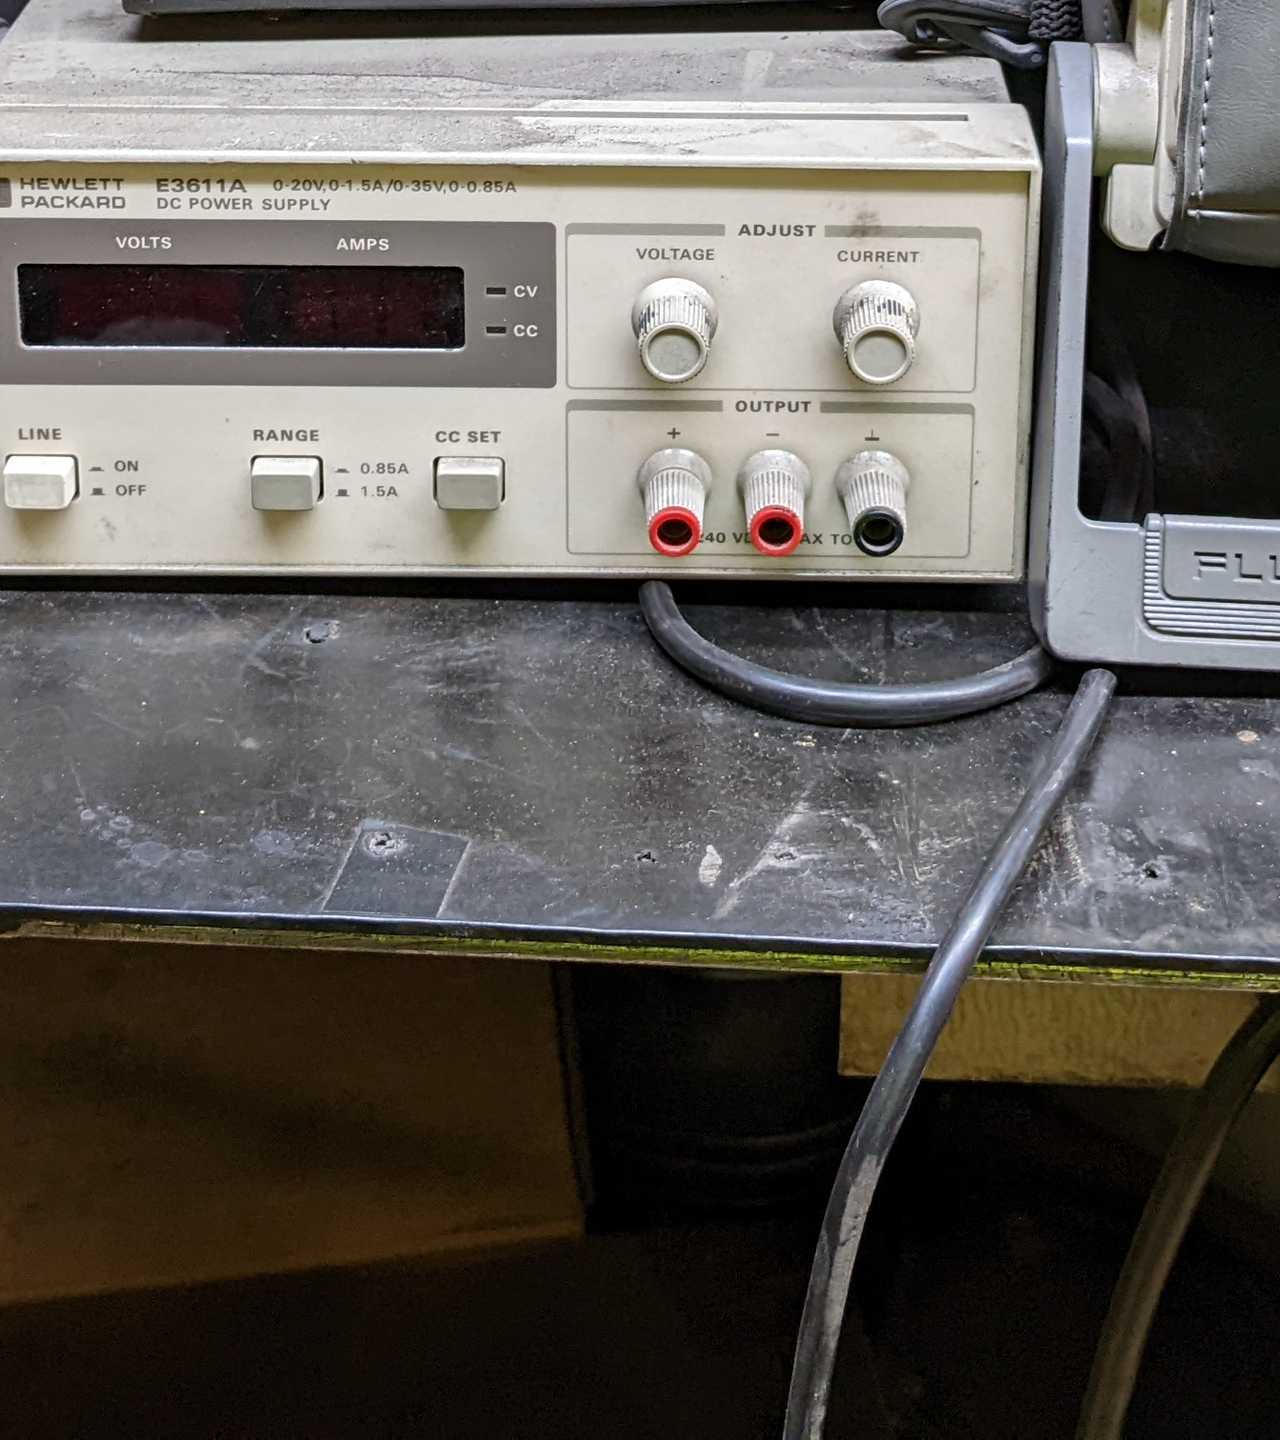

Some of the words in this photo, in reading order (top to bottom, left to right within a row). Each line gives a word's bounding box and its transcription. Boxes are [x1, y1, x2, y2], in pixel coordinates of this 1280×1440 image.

[21, 177, 124, 191] HEWLETT
[156, 178, 247, 193] E3611A
[21, 195, 126, 209] PACKARD
[156, 197, 182, 209] DC
[189, 198, 253, 210] POWER
[262, 198, 331, 211] SUPPLY
[738, 224, 816, 238] ADJUST
[116, 236, 172, 249] VOLTS
[336, 238, 390, 251] AMPS
[636, 248, 715, 261] VOLTAGE
[837, 250, 920, 263] CURRENT
[513, 285, 538, 298] CV
[513, 324, 538, 337] CC
[735, 400, 812, 413] OUTPUT
[18, 428, 62, 440] LINE
[252, 429, 320, 442] RANGE
[435, 430, 461, 443] CC
[467, 430, 502, 443] SET
[114, 460, 139, 472] ON
[360, 462, 409, 475] 0.85A
[115, 484, 147, 496] OFF
[360, 485, 398, 498] 1.5A
[830, 533, 853, 546] TO
